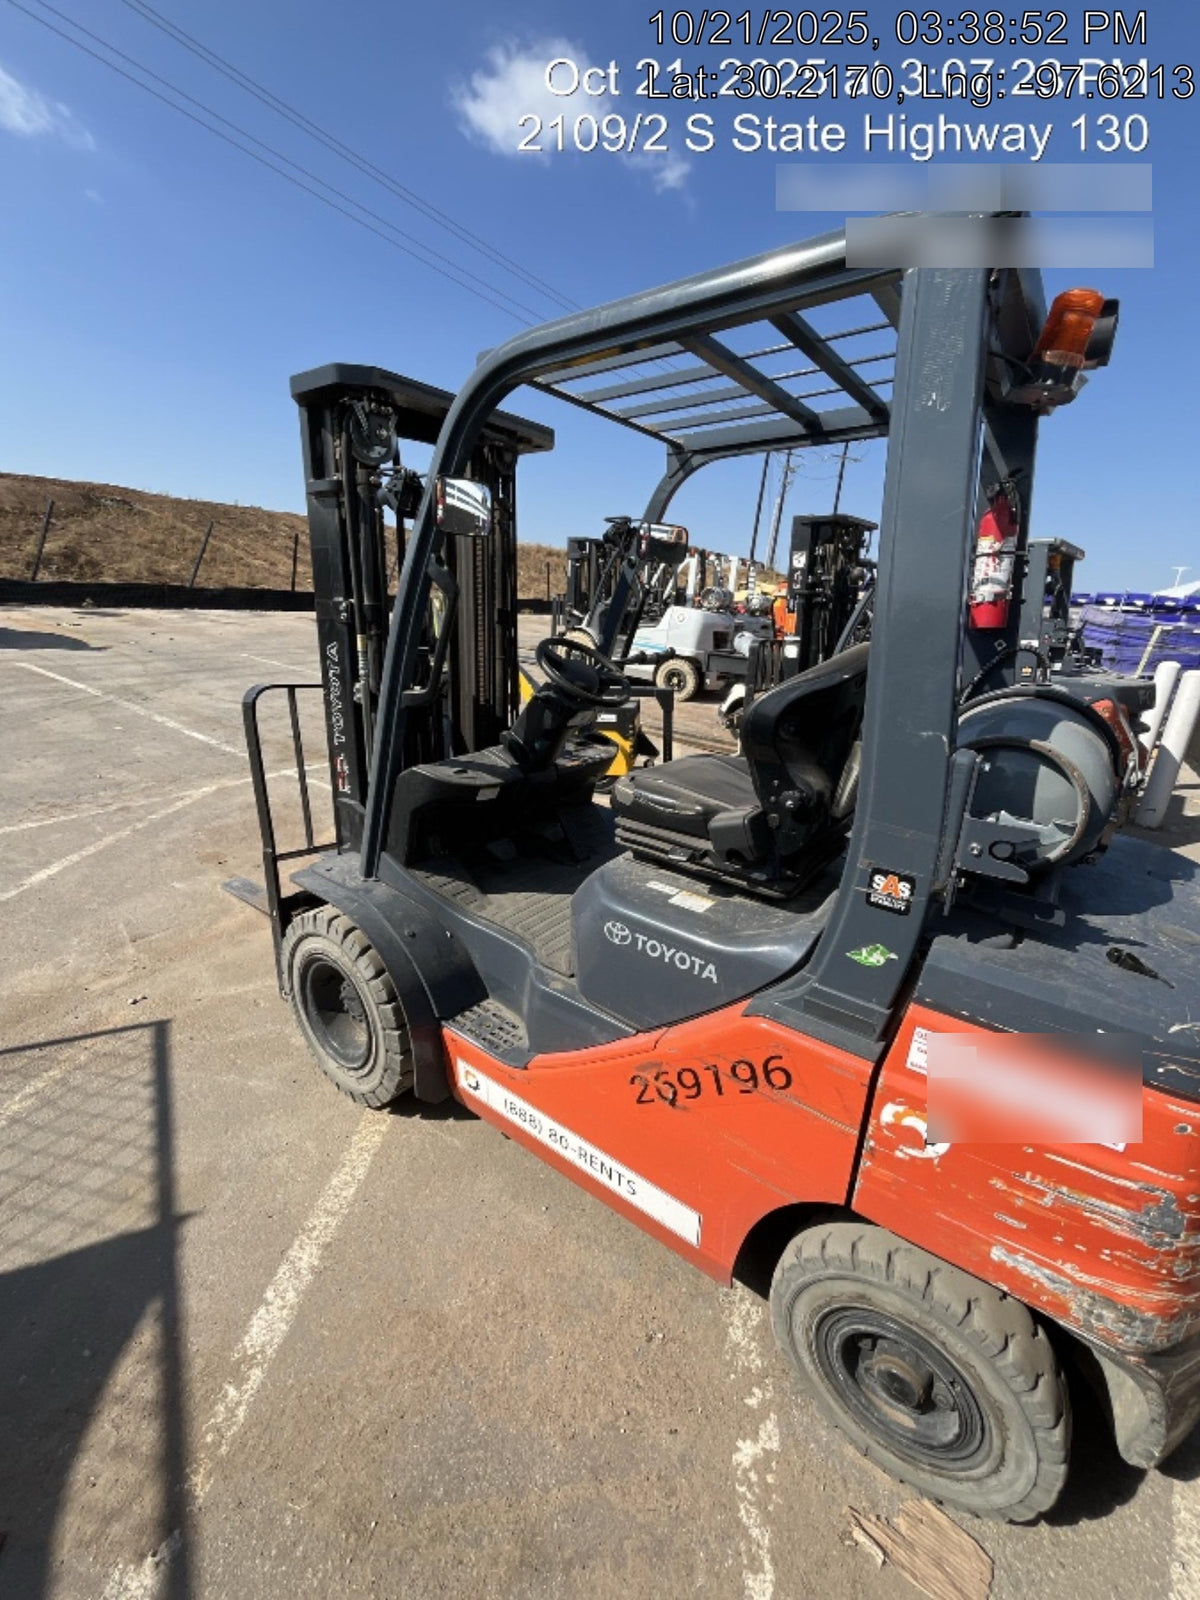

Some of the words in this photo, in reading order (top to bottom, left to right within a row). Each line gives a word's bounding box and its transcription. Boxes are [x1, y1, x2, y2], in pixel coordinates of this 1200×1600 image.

[326, 641, 346, 745] TOYOTA
[872, 873, 912, 900] SAS
[635, 933, 720, 984] TOYOTA
[548, 1128, 638, 1196] 80-RENTS
